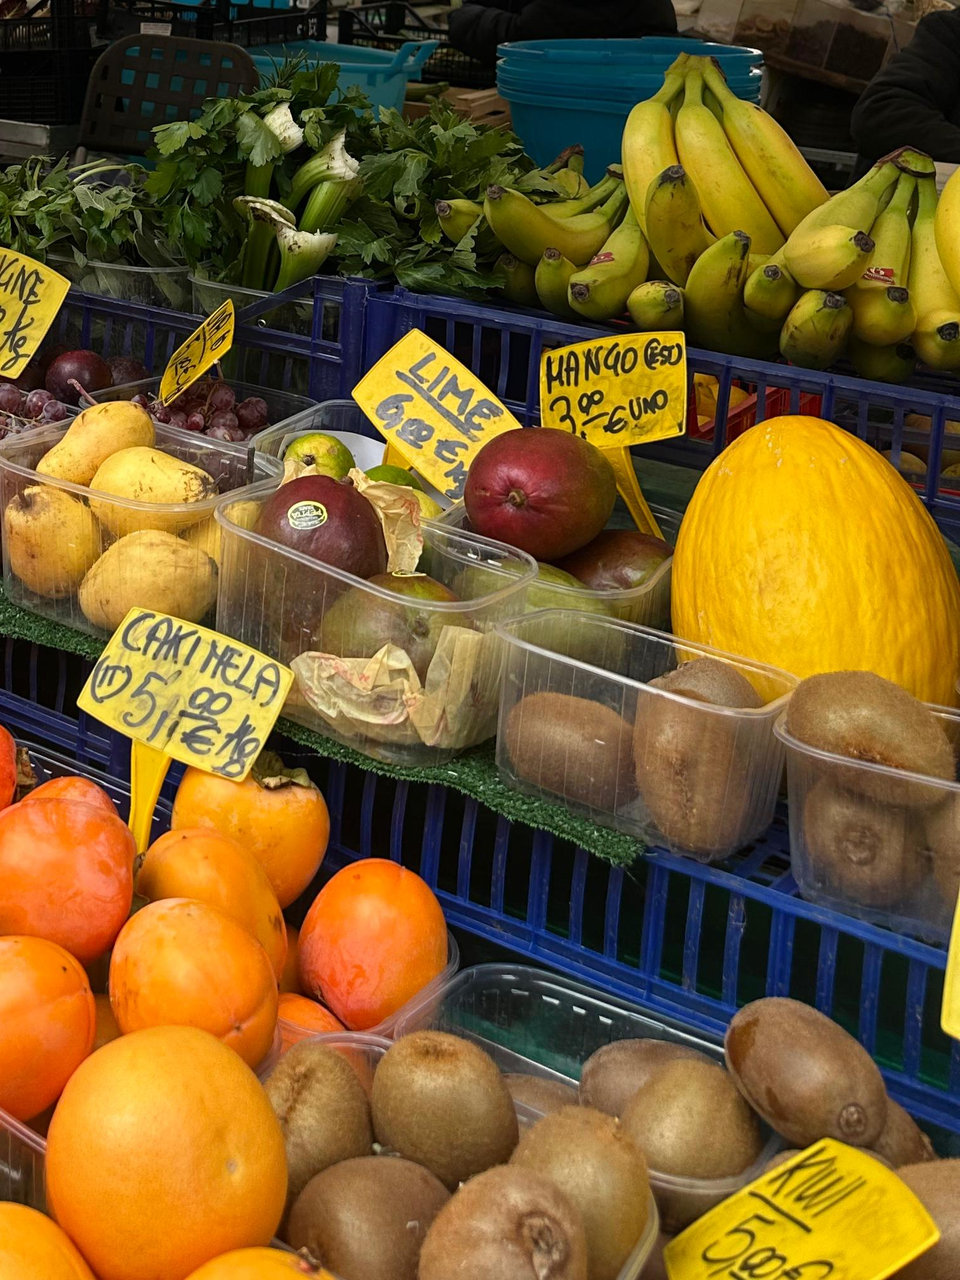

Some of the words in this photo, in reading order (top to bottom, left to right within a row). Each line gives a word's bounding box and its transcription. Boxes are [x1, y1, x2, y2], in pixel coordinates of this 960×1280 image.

[408, 351, 505, 432] LIME
[545, 342, 639, 395] MANGO
[628, 389, 669, 422] UNO
[433, 438, 470, 464] €
[121, 611, 202, 668] CAKI
[199, 638, 282, 708] MELA
